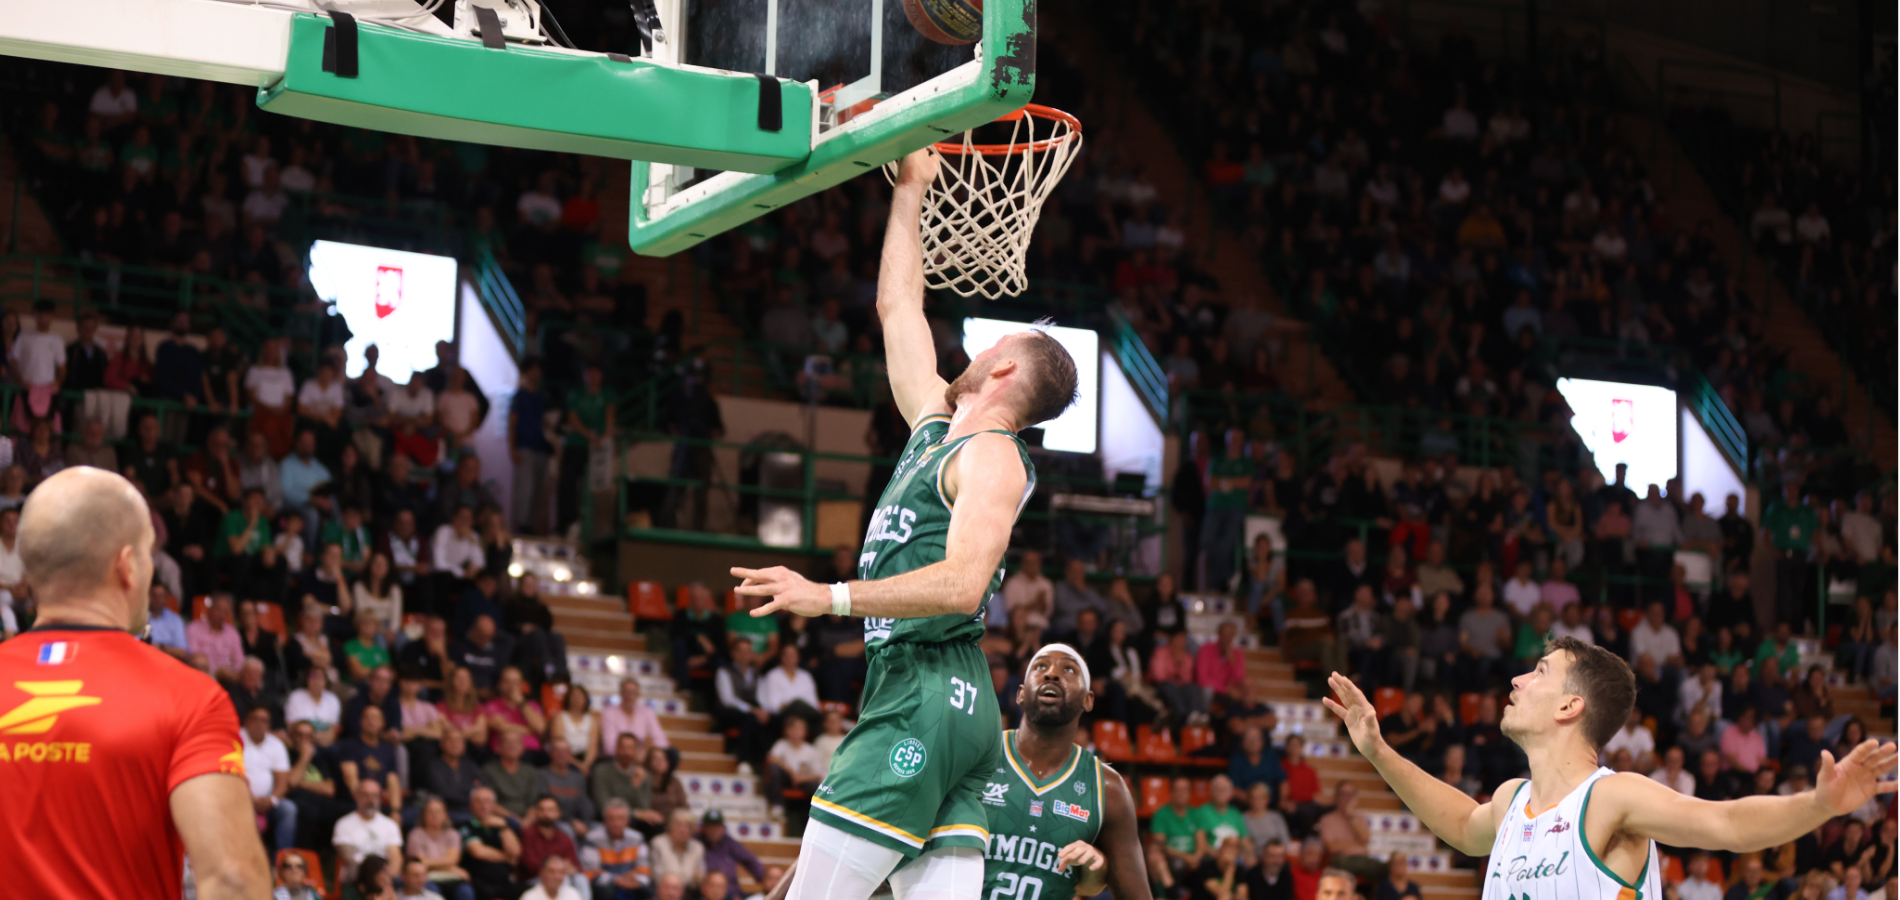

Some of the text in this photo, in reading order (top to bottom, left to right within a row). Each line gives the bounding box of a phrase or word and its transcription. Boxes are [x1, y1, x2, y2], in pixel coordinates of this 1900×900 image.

[950, 676, 978, 715] 37
[0, 742, 92, 763] A POSTE
[894, 745, 922, 767] CSP
[1055, 800, 1090, 819] BigMat
[989, 871, 1043, 900] 20
